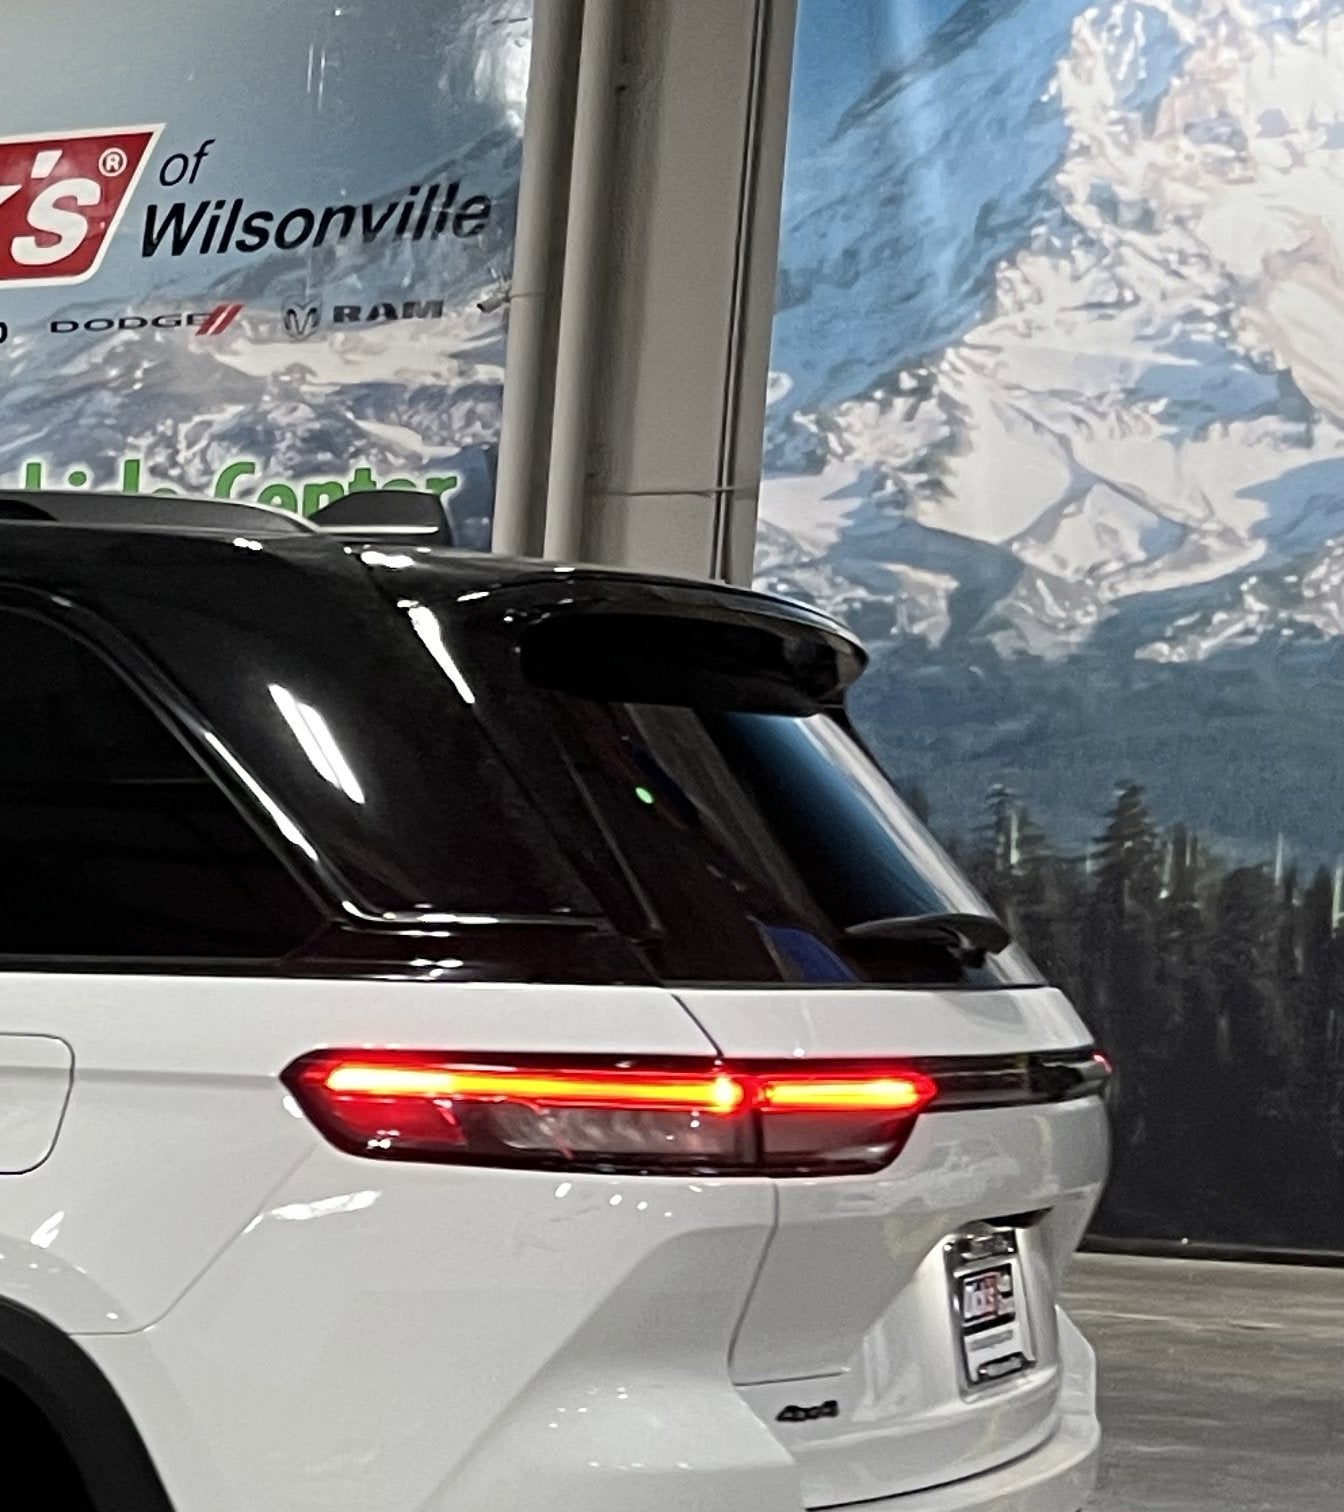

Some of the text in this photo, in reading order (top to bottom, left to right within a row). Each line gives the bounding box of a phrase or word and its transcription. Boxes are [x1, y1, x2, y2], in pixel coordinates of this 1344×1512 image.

[158, 138, 216, 187] of
[141, 180, 493, 258] Wilsonville
[49, 312, 210, 334] DODGE
[332, 301, 444, 323] RAM
